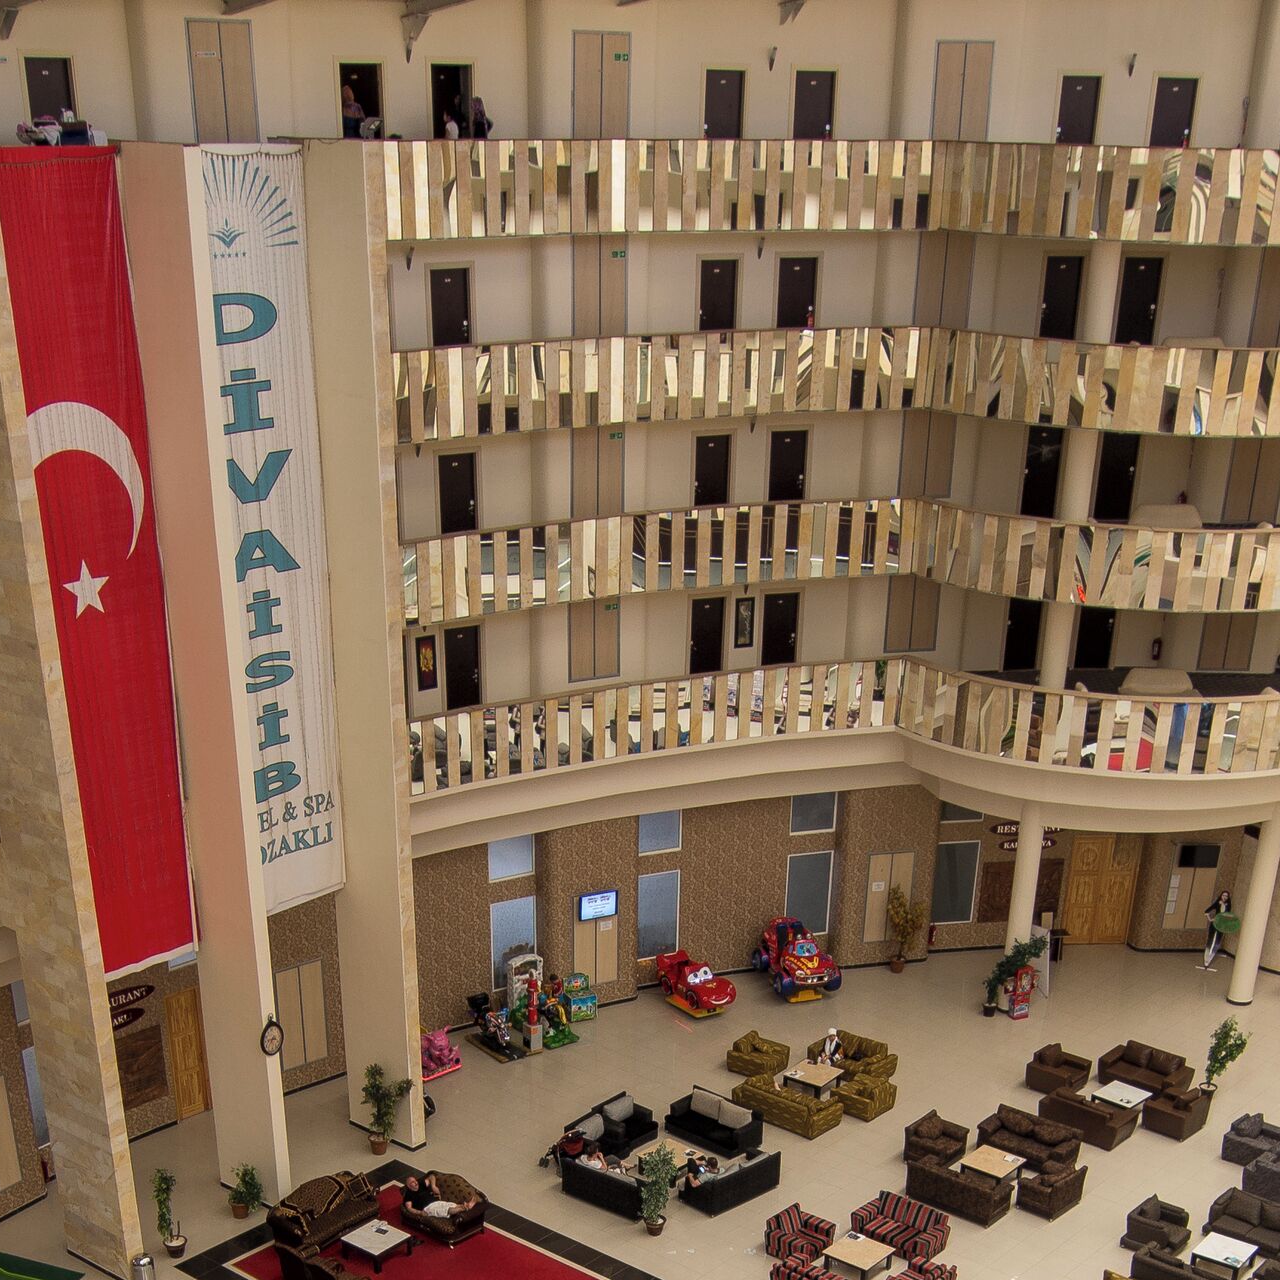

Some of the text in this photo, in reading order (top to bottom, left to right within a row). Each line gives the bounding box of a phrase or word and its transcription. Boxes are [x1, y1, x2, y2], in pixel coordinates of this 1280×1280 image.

[282, 801, 298, 822] &
[303, 790, 335, 818] SPA
[110, 988, 146, 1007] URANT
